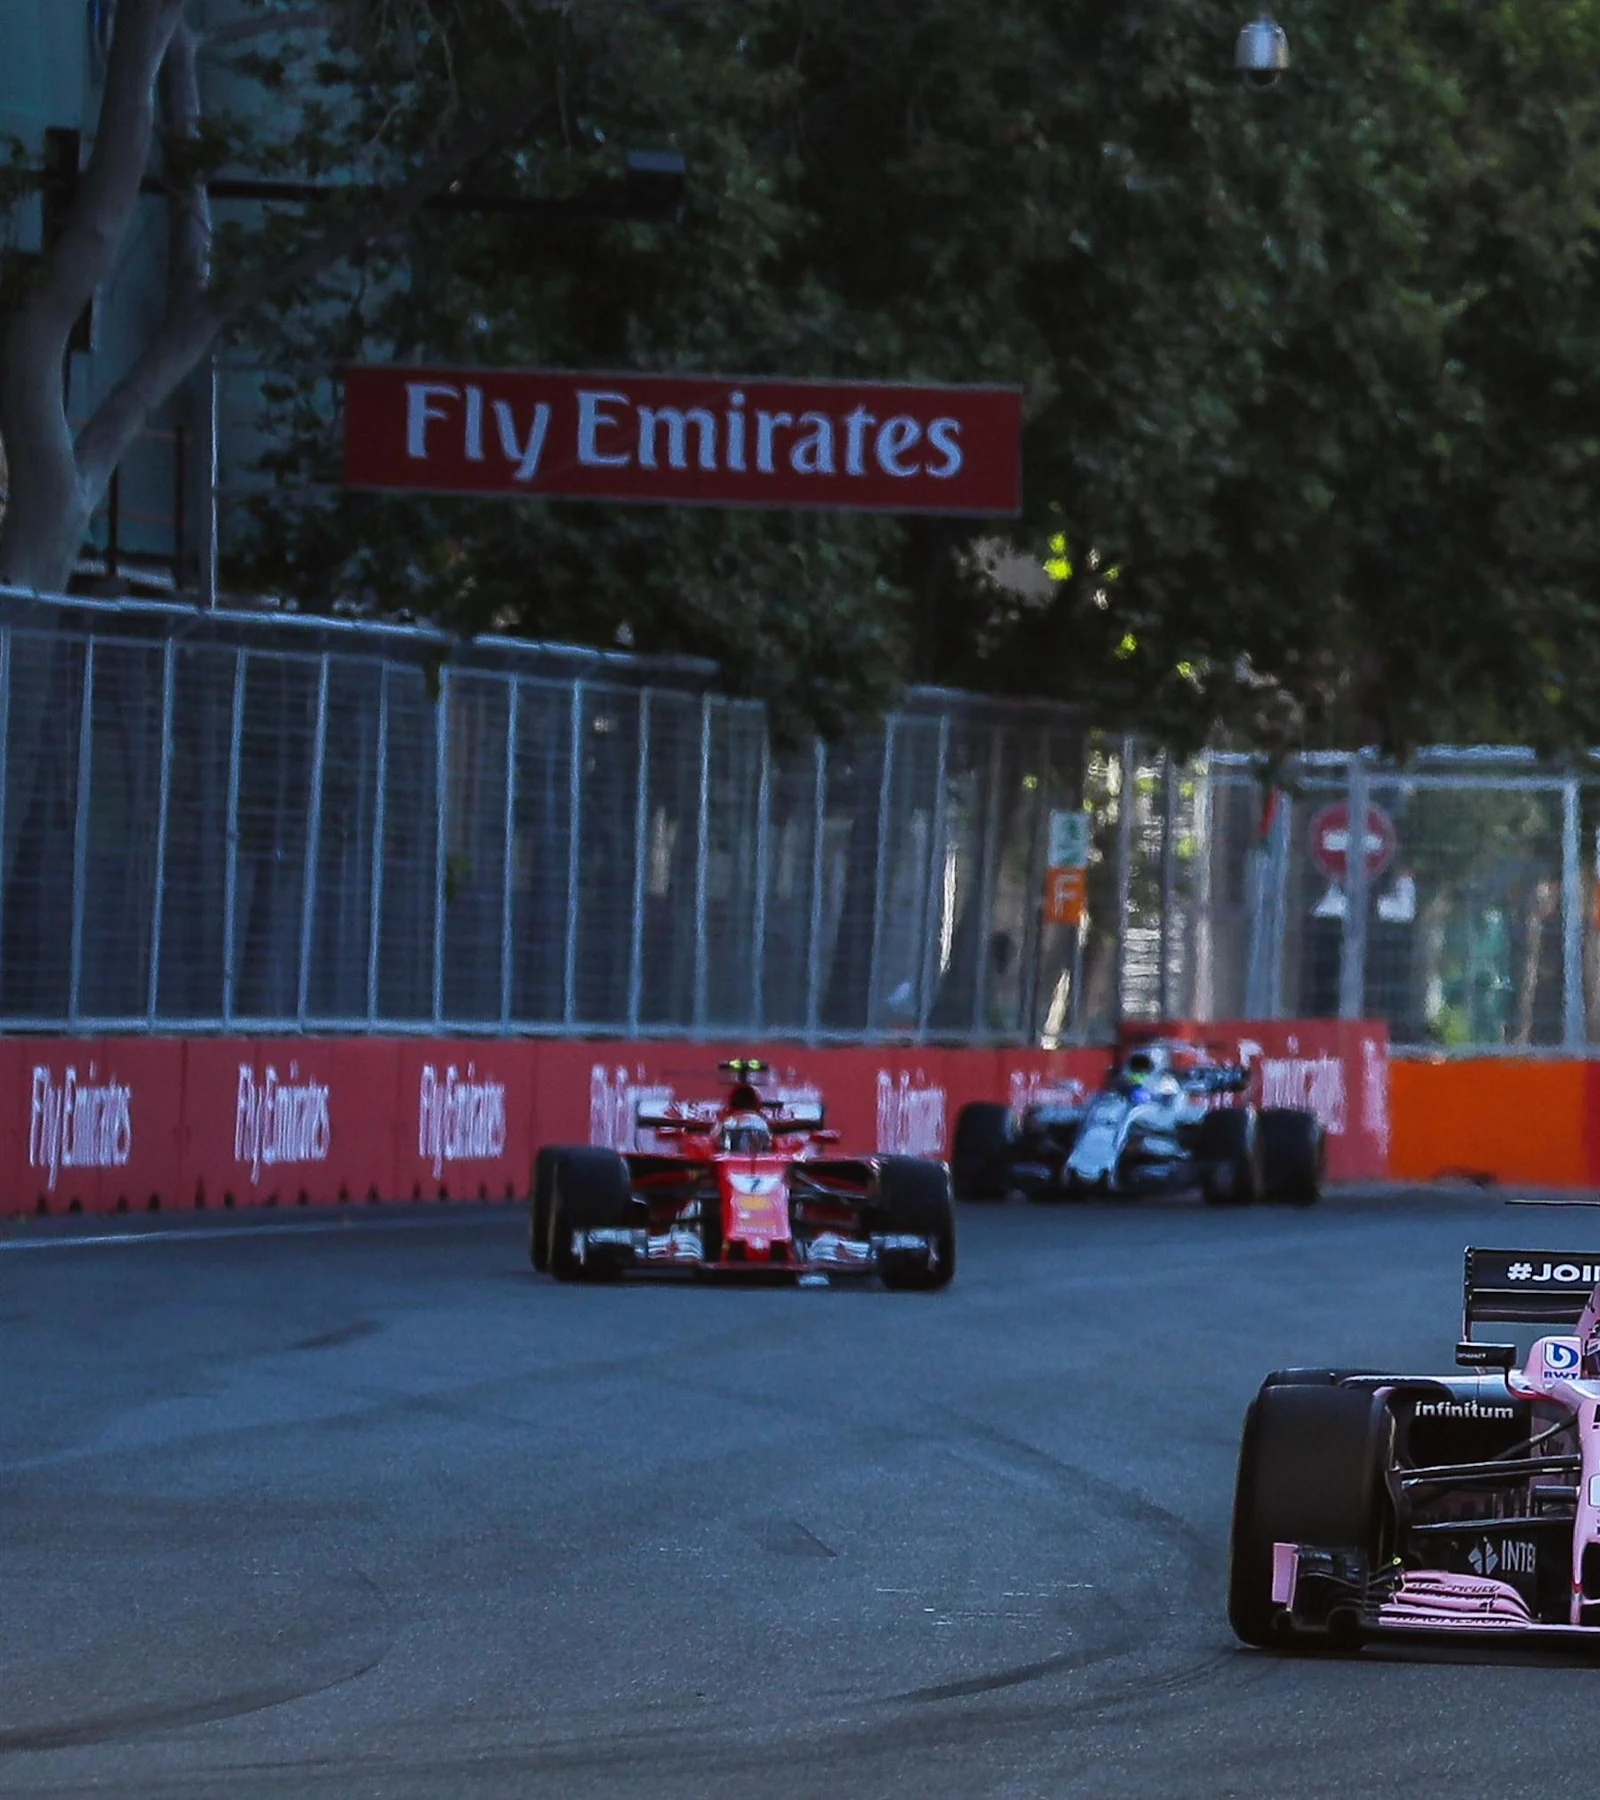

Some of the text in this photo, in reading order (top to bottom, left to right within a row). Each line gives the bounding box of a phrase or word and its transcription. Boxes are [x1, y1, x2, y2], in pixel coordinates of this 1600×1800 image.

[406, 382, 963, 482] Fly Emirates
[1054, 873, 1081, 917] F
[1415, 1399, 1514, 1419] infinitum
